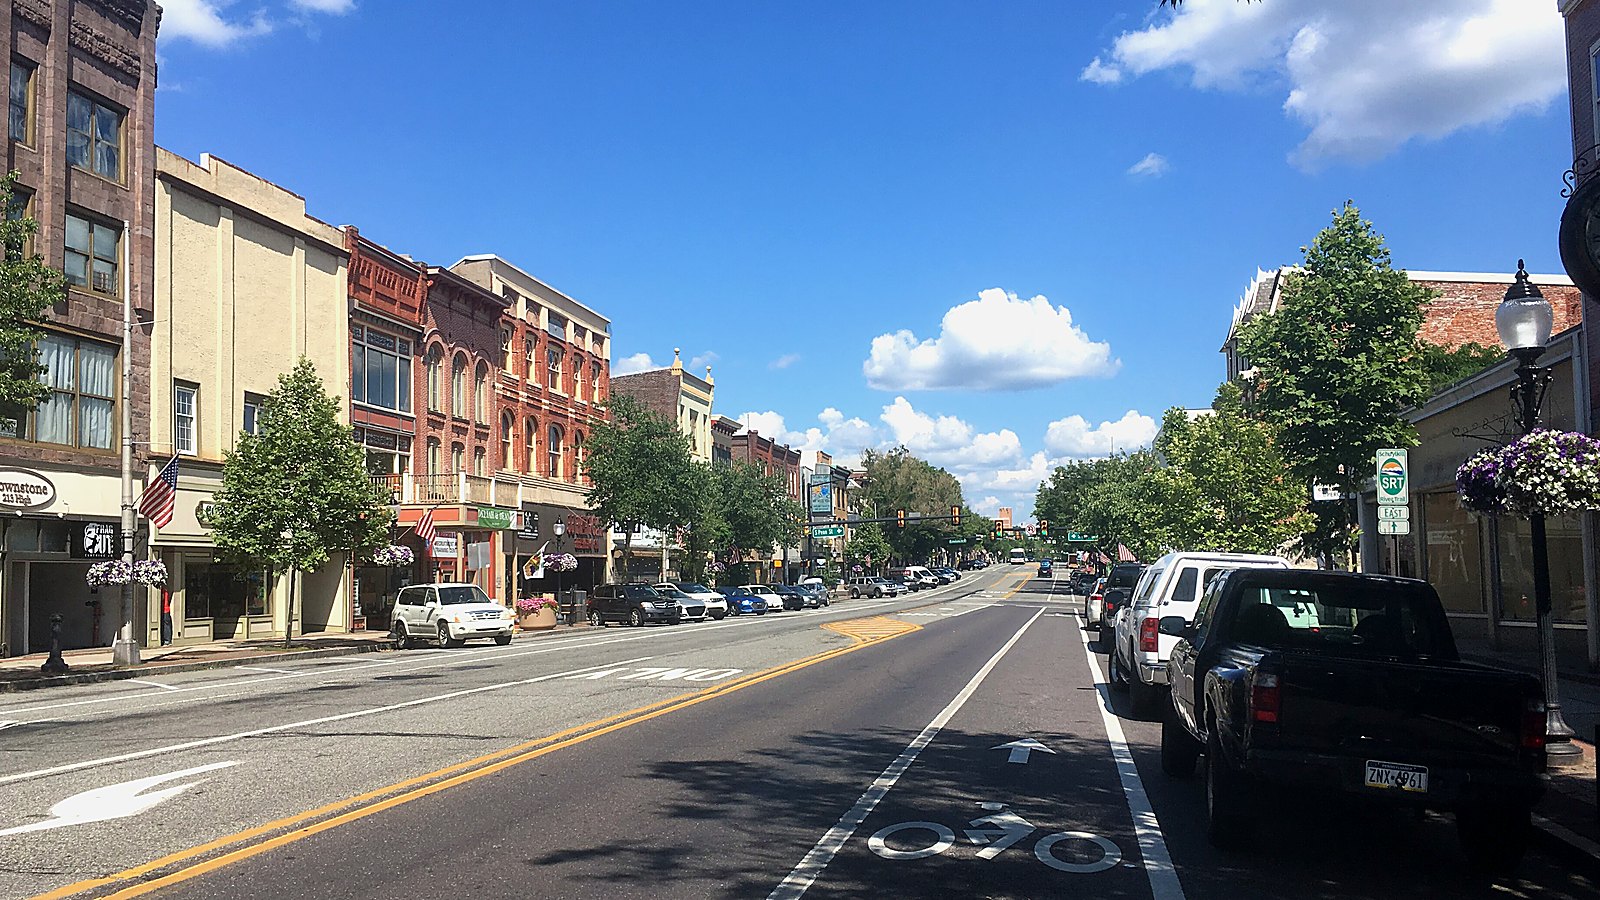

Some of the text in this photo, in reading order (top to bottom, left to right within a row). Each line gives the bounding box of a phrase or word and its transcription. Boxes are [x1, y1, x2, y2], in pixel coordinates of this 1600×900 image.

[1382, 477, 1404, 489] SRT
[1384, 508, 1402, 518] EAST
[565, 667, 743, 681] ONLY
